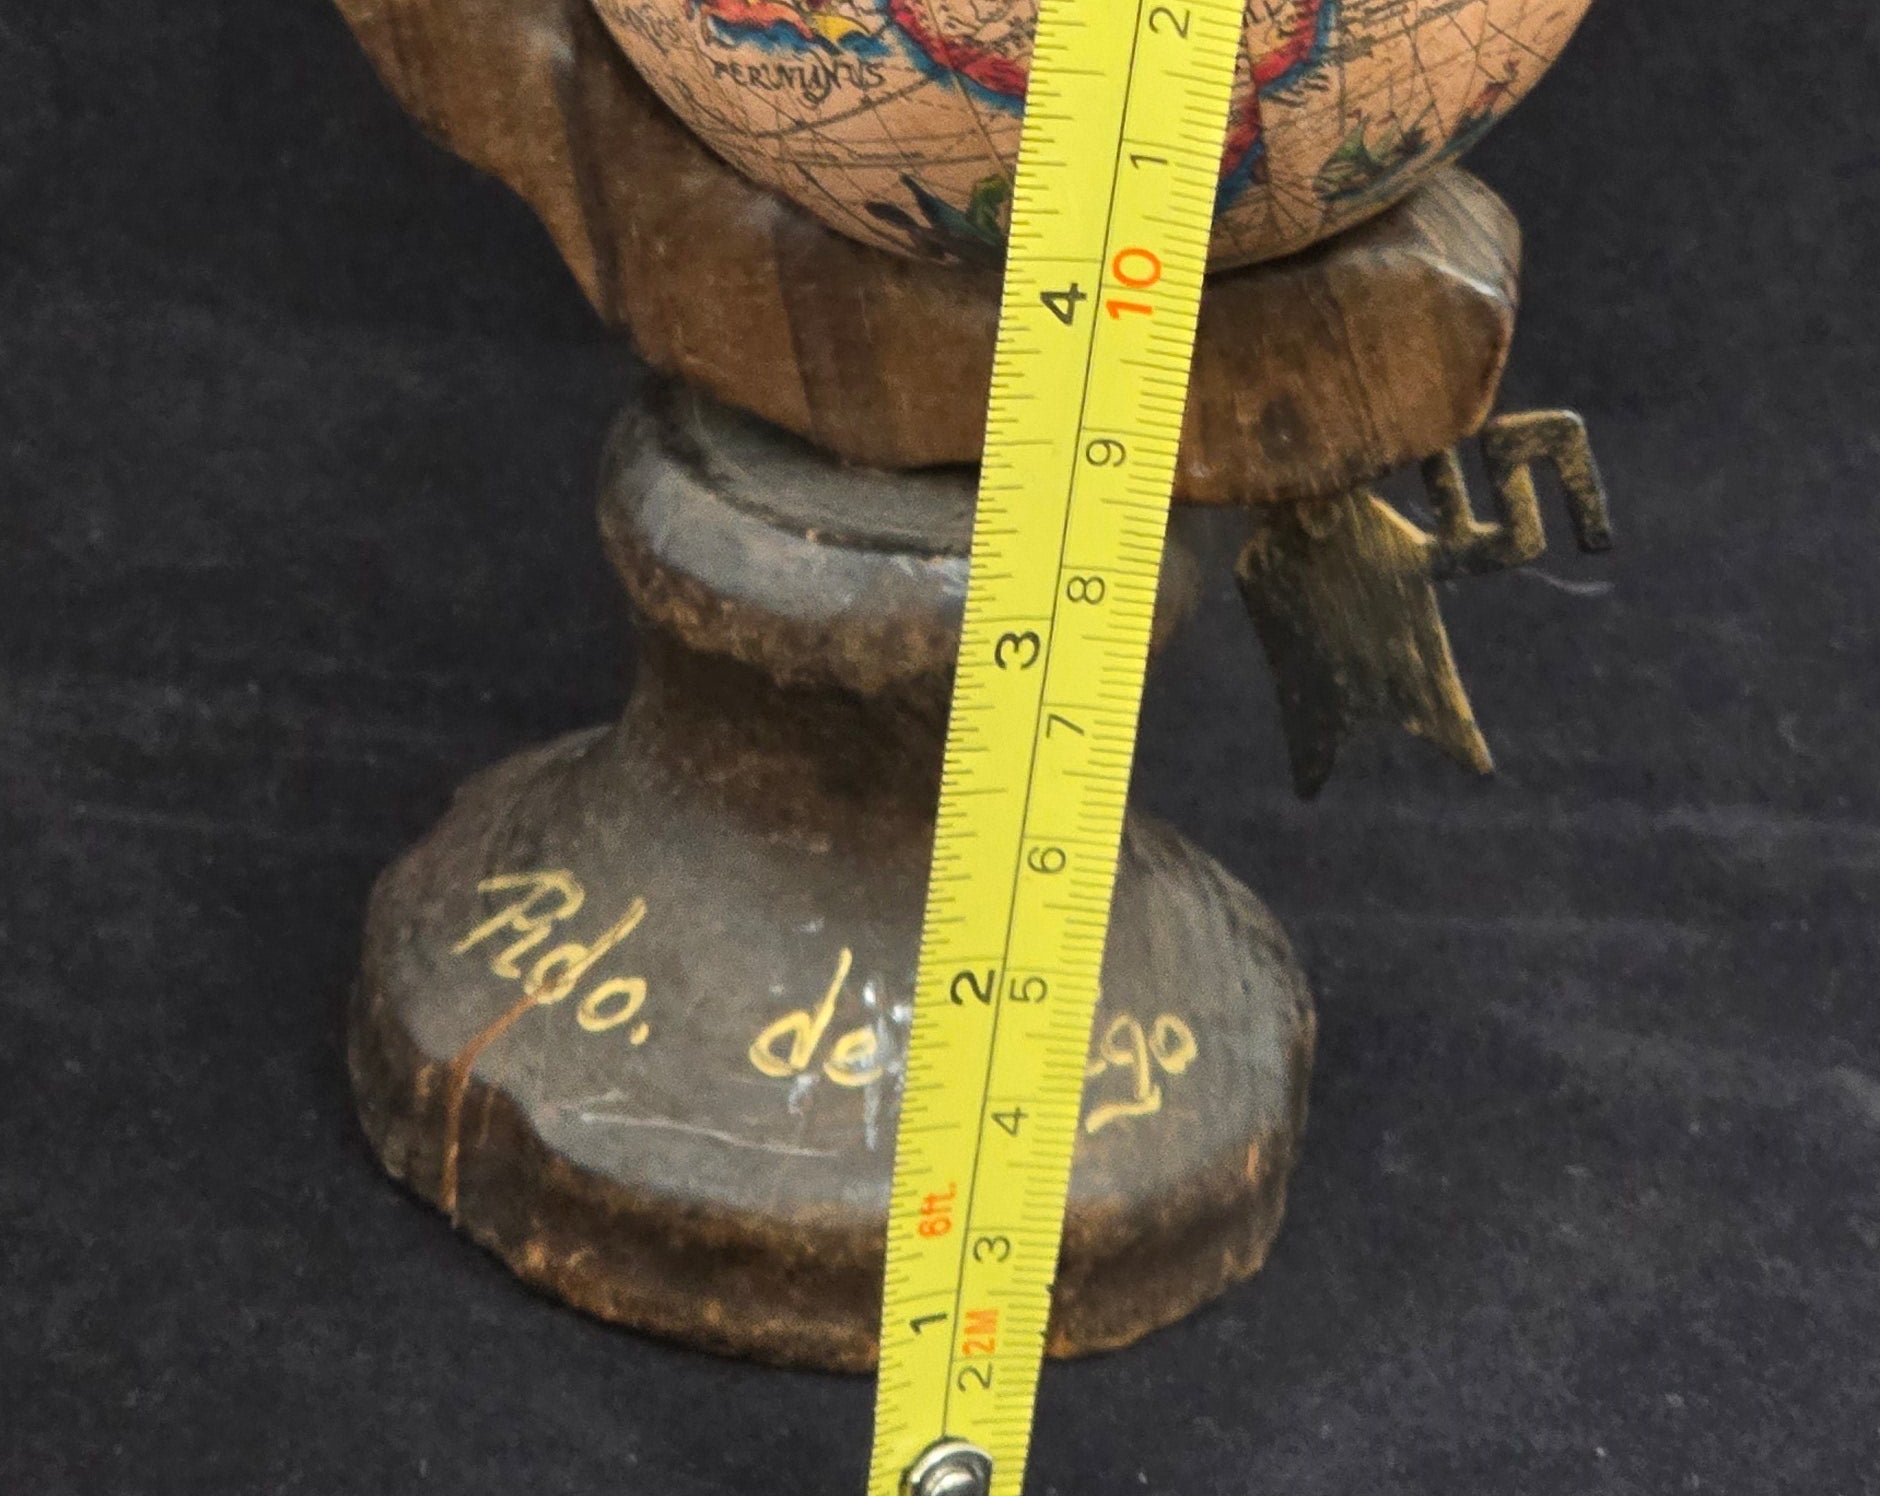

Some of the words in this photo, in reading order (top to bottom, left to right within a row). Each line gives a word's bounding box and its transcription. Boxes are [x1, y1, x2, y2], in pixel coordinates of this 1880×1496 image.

[1149, 7, 1190, 38] 2
[1129, 151, 1168, 170] 1
[1107, 249, 1160, 318] 10
[1040, 283, 1086, 325] 4
[1086, 439, 1126, 466] 9
[1067, 577, 1105, 604] 8
[994, 630, 1041, 670] 3
[1046, 713, 1087, 741] 7
[1028, 848, 1066, 873] 6
[950, 970, 994, 1005] 2
[1009, 977, 1047, 1003] 5
[992, 1108, 1027, 1135] 4
[973, 1236, 1010, 1262] 3
[910, 1314, 947, 1334] 1
[962, 1308, 1000, 1354] 2M
[958, 1364, 992, 1391] 2
